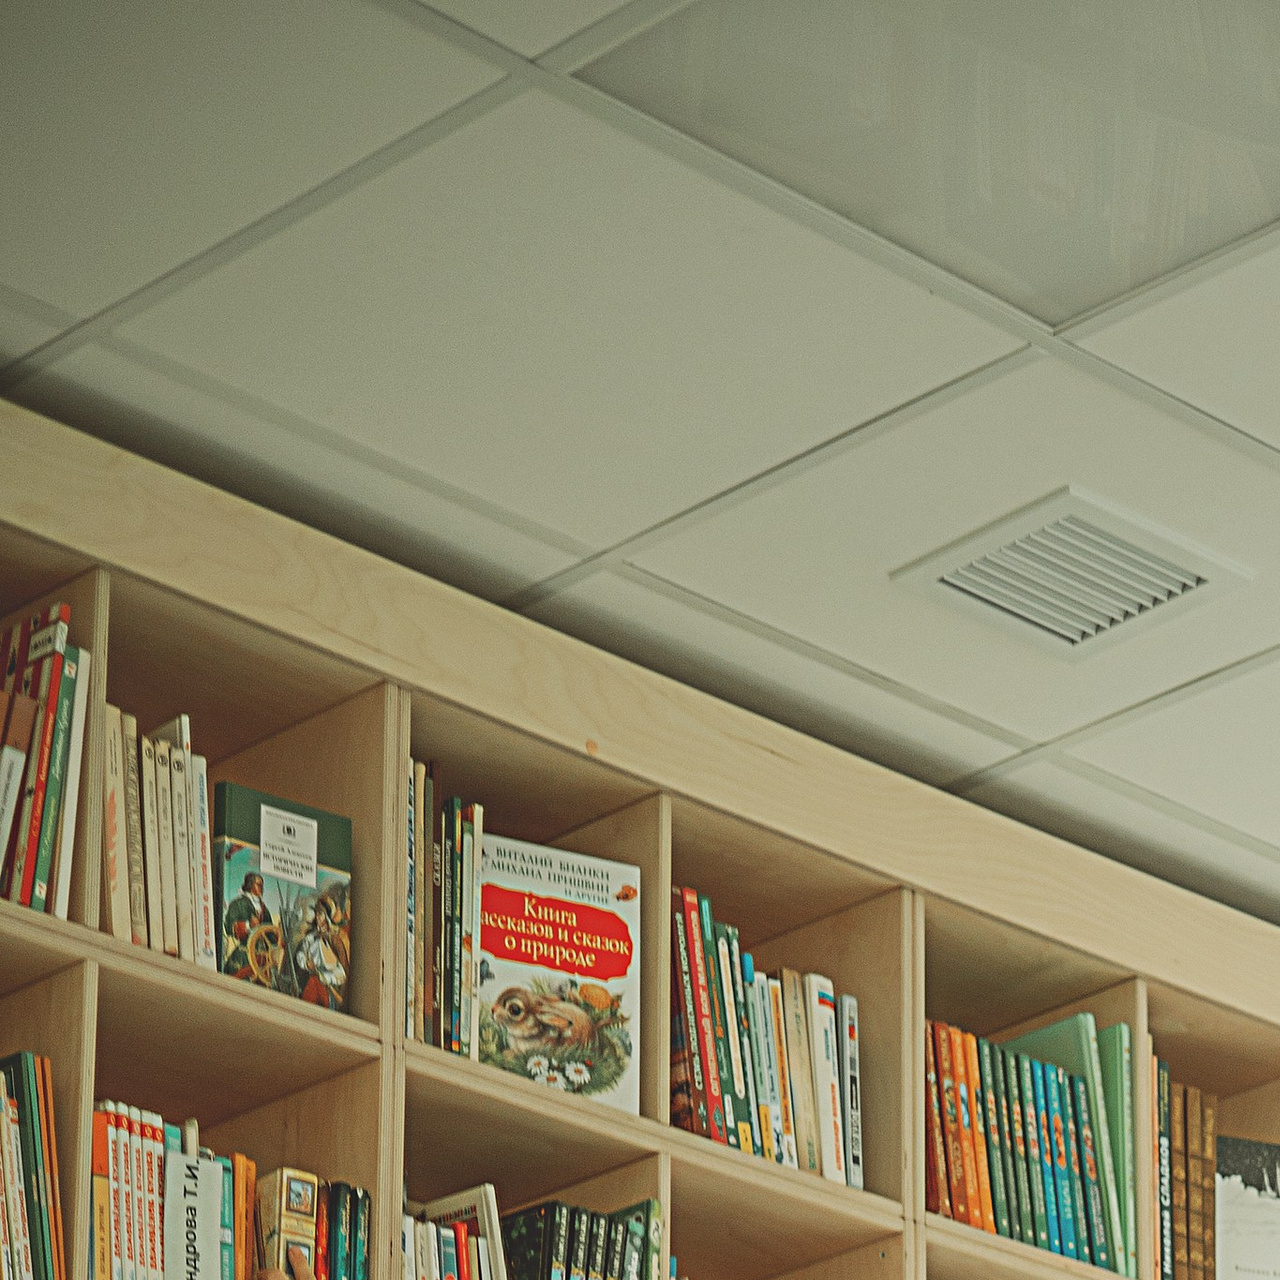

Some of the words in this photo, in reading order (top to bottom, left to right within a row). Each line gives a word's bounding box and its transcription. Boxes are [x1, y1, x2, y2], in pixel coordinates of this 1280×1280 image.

[490, 858, 543, 881] МИХАИЛ
[547, 872, 611, 895] ПРИШВИН
[496, 846, 554, 869] ВИТАЛИЙ
[559, 860, 611, 882] БИАНКИ
[524, 896, 578, 928] Книга
[504, 934, 517, 951] о
[520, 937, 596, 968] природе
[557, 926, 569, 944] и
[572, 931, 631, 956] сказок
[183, 1158, 201, 1199] Т.И.
[1159, 1136, 1172, 1207] СЛАДКОВ
[1160, 1210, 1173, 1275] Николай
